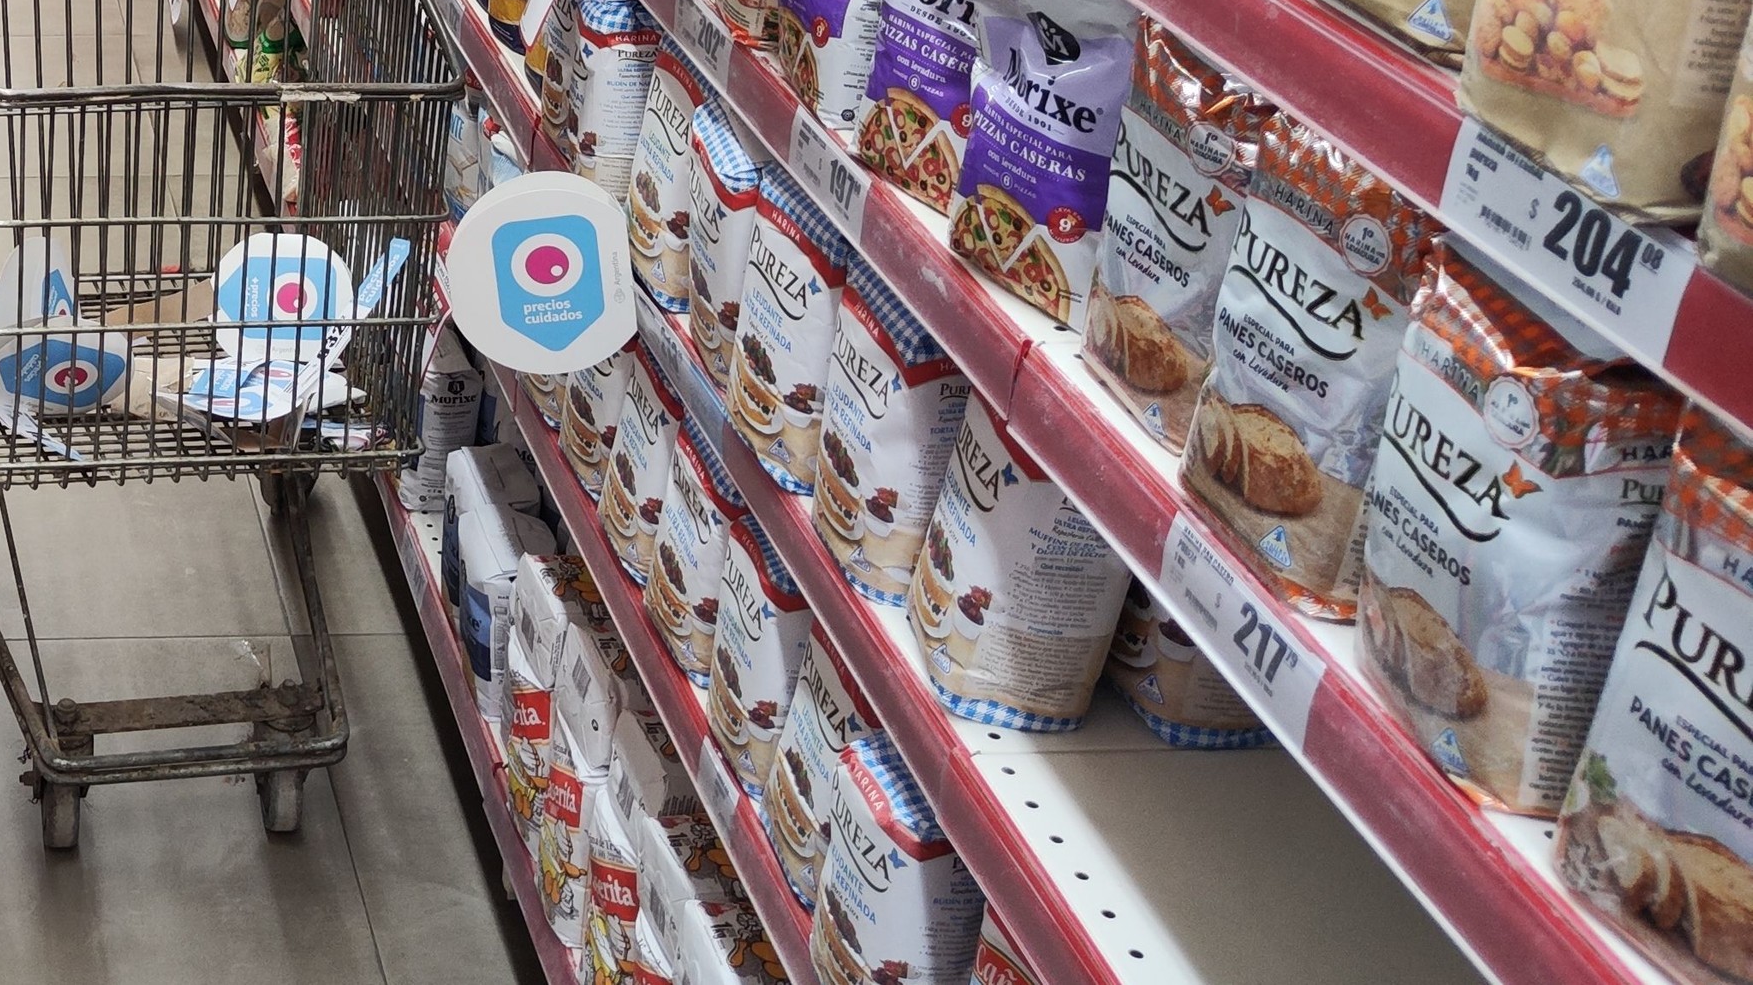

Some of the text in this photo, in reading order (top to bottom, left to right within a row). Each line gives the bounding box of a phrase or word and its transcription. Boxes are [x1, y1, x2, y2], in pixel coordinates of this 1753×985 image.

[881, 19, 919, 51] PIZZAS
[910, 5, 942, 25] DESDE
[698, 19, 721, 63] 202
[910, 62, 947, 84] levadura
[1003, 47, 1097, 133] Morixe
[650, 74, 690, 146] PUREZA
[973, 109, 1087, 182] PIZZAS CASERAS
[1005, 121, 1043, 151] ESPECIAL
[830, 160, 854, 208] 197
[1001, 156, 1038, 185] levadura
[1112, 119, 1212, 238] PUREZA
[771, 209, 801, 243] HARINA
[1275, 184, 1334, 236] HARINA
[749, 224, 809, 311] PUREZA
[1134, 236, 1190, 289] CASEROS
[1529, 189, 1643, 299] $ 204
[1233, 204, 1365, 341] PUREZA
[523, 299, 571, 315] precios
[525, 309, 583, 325] cuidados
[752, 287, 783, 328] LEUDANTE
[854, 301, 880, 338] HARINA
[1243, 314, 1275, 344] ESPECIAL
[759, 312, 792, 354] REFINADA
[1219, 306, 1330, 400] PANES CASEROS
[834, 314, 890, 409] PUREZA
[1248, 355, 1290, 394] Levadura
[431, 390, 477, 405] Morixe
[832, 381, 865, 425] LEUDANTE
[838, 408, 873, 454] REFINADA
[1402, 516, 1472, 587] CASEROS
[1233, 602, 1288, 684] 217
[802, 645, 849, 745] PUREZA
[1630, 696, 1693, 763] PANES
[832, 766, 892, 883] PUREZA
[835, 870, 878, 926] REFINADA
